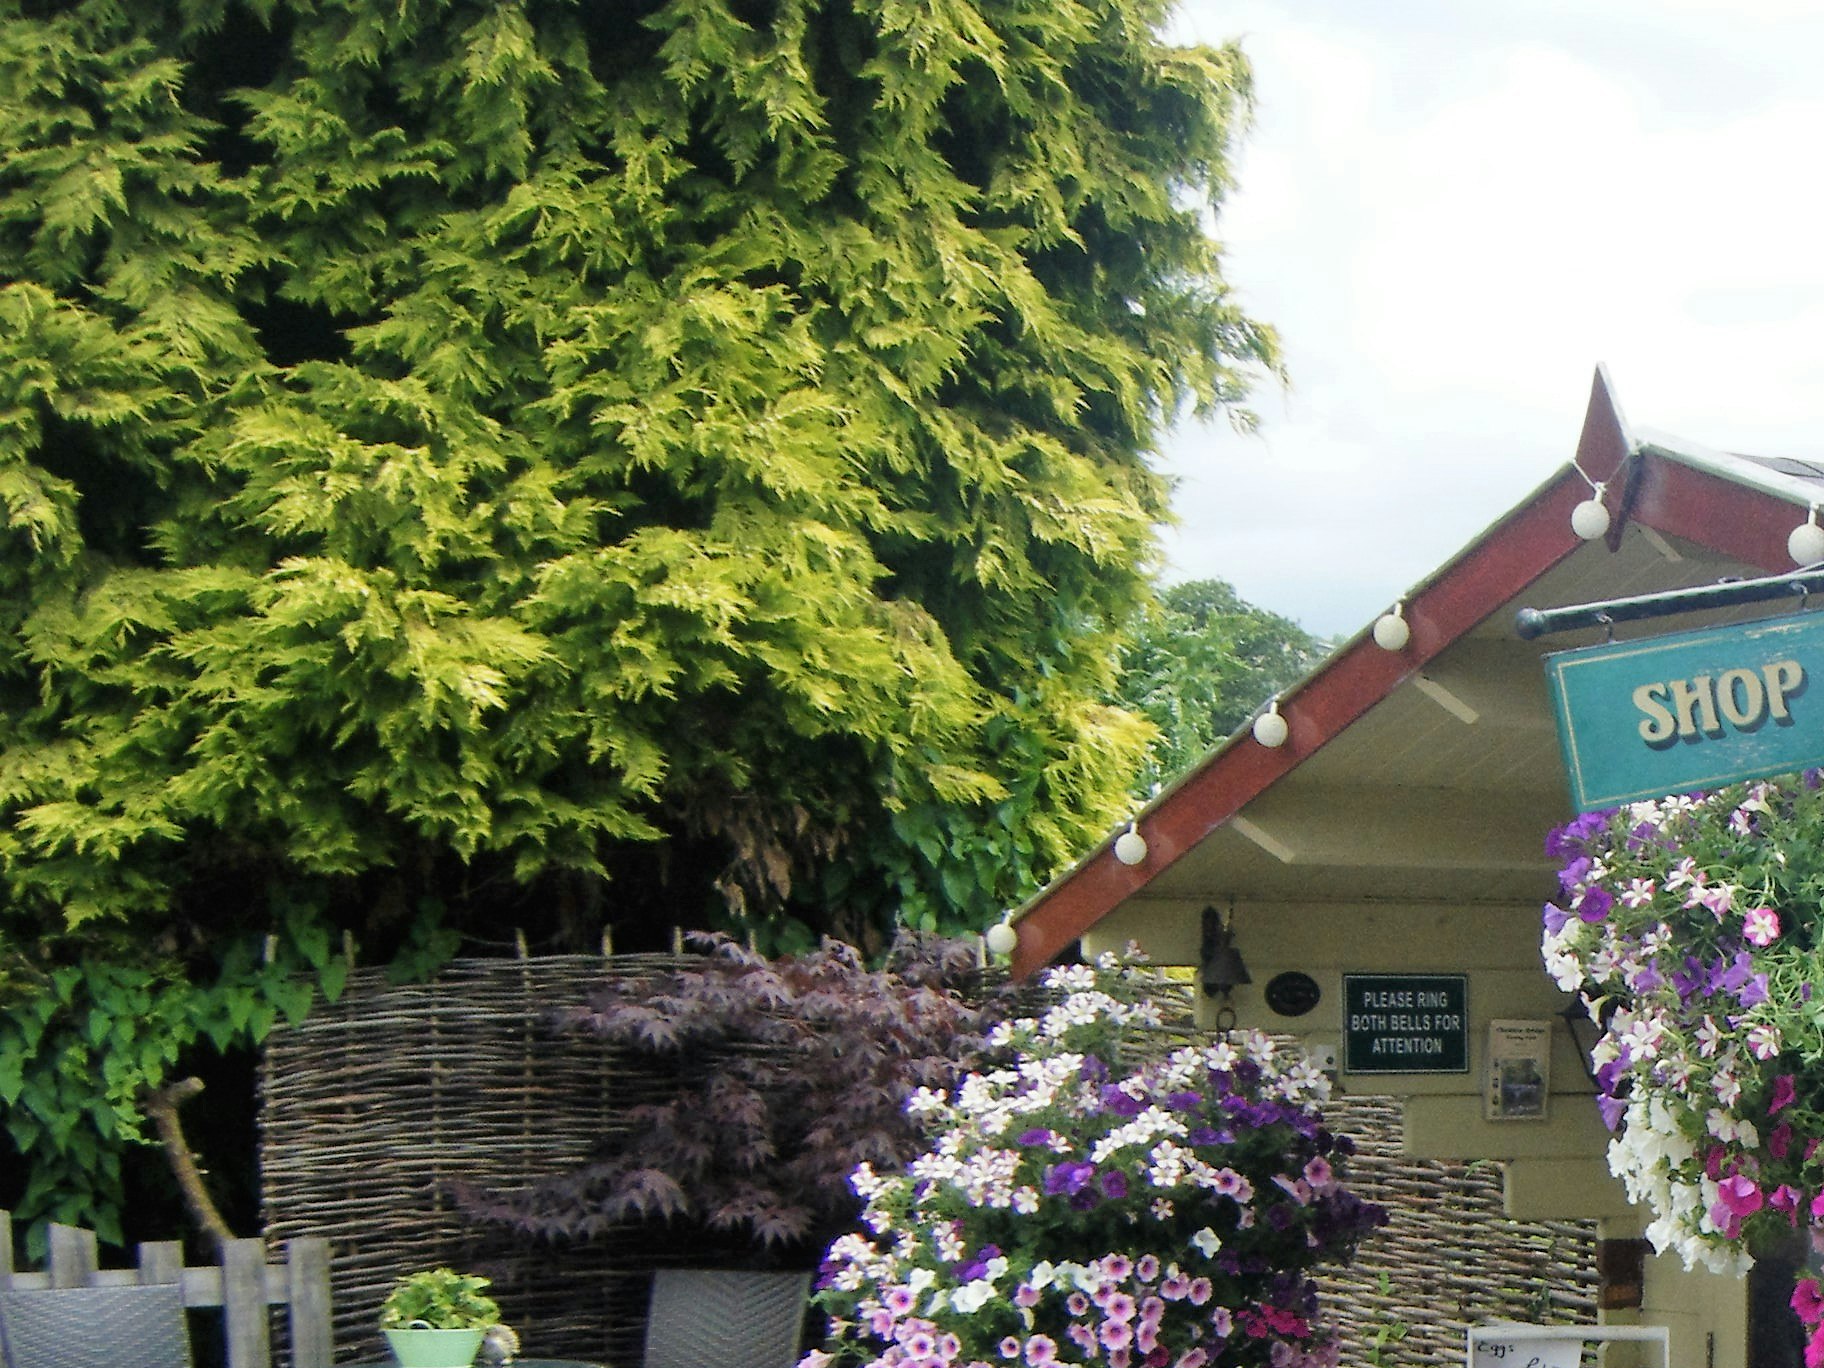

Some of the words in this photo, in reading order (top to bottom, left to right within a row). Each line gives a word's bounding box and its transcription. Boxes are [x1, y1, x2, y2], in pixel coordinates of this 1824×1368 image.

[1632, 658, 1807, 748] SHOP
[1363, 991, 1414, 1008] PLEASE
[1417, 991, 1448, 1008] RING
[1351, 1014, 1387, 1031] BOTH
[1390, 1014, 1431, 1031] BELLS
[1434, 1015, 1460, 1031] FOR
[1371, 1037, 1443, 1054] ATTENTION
